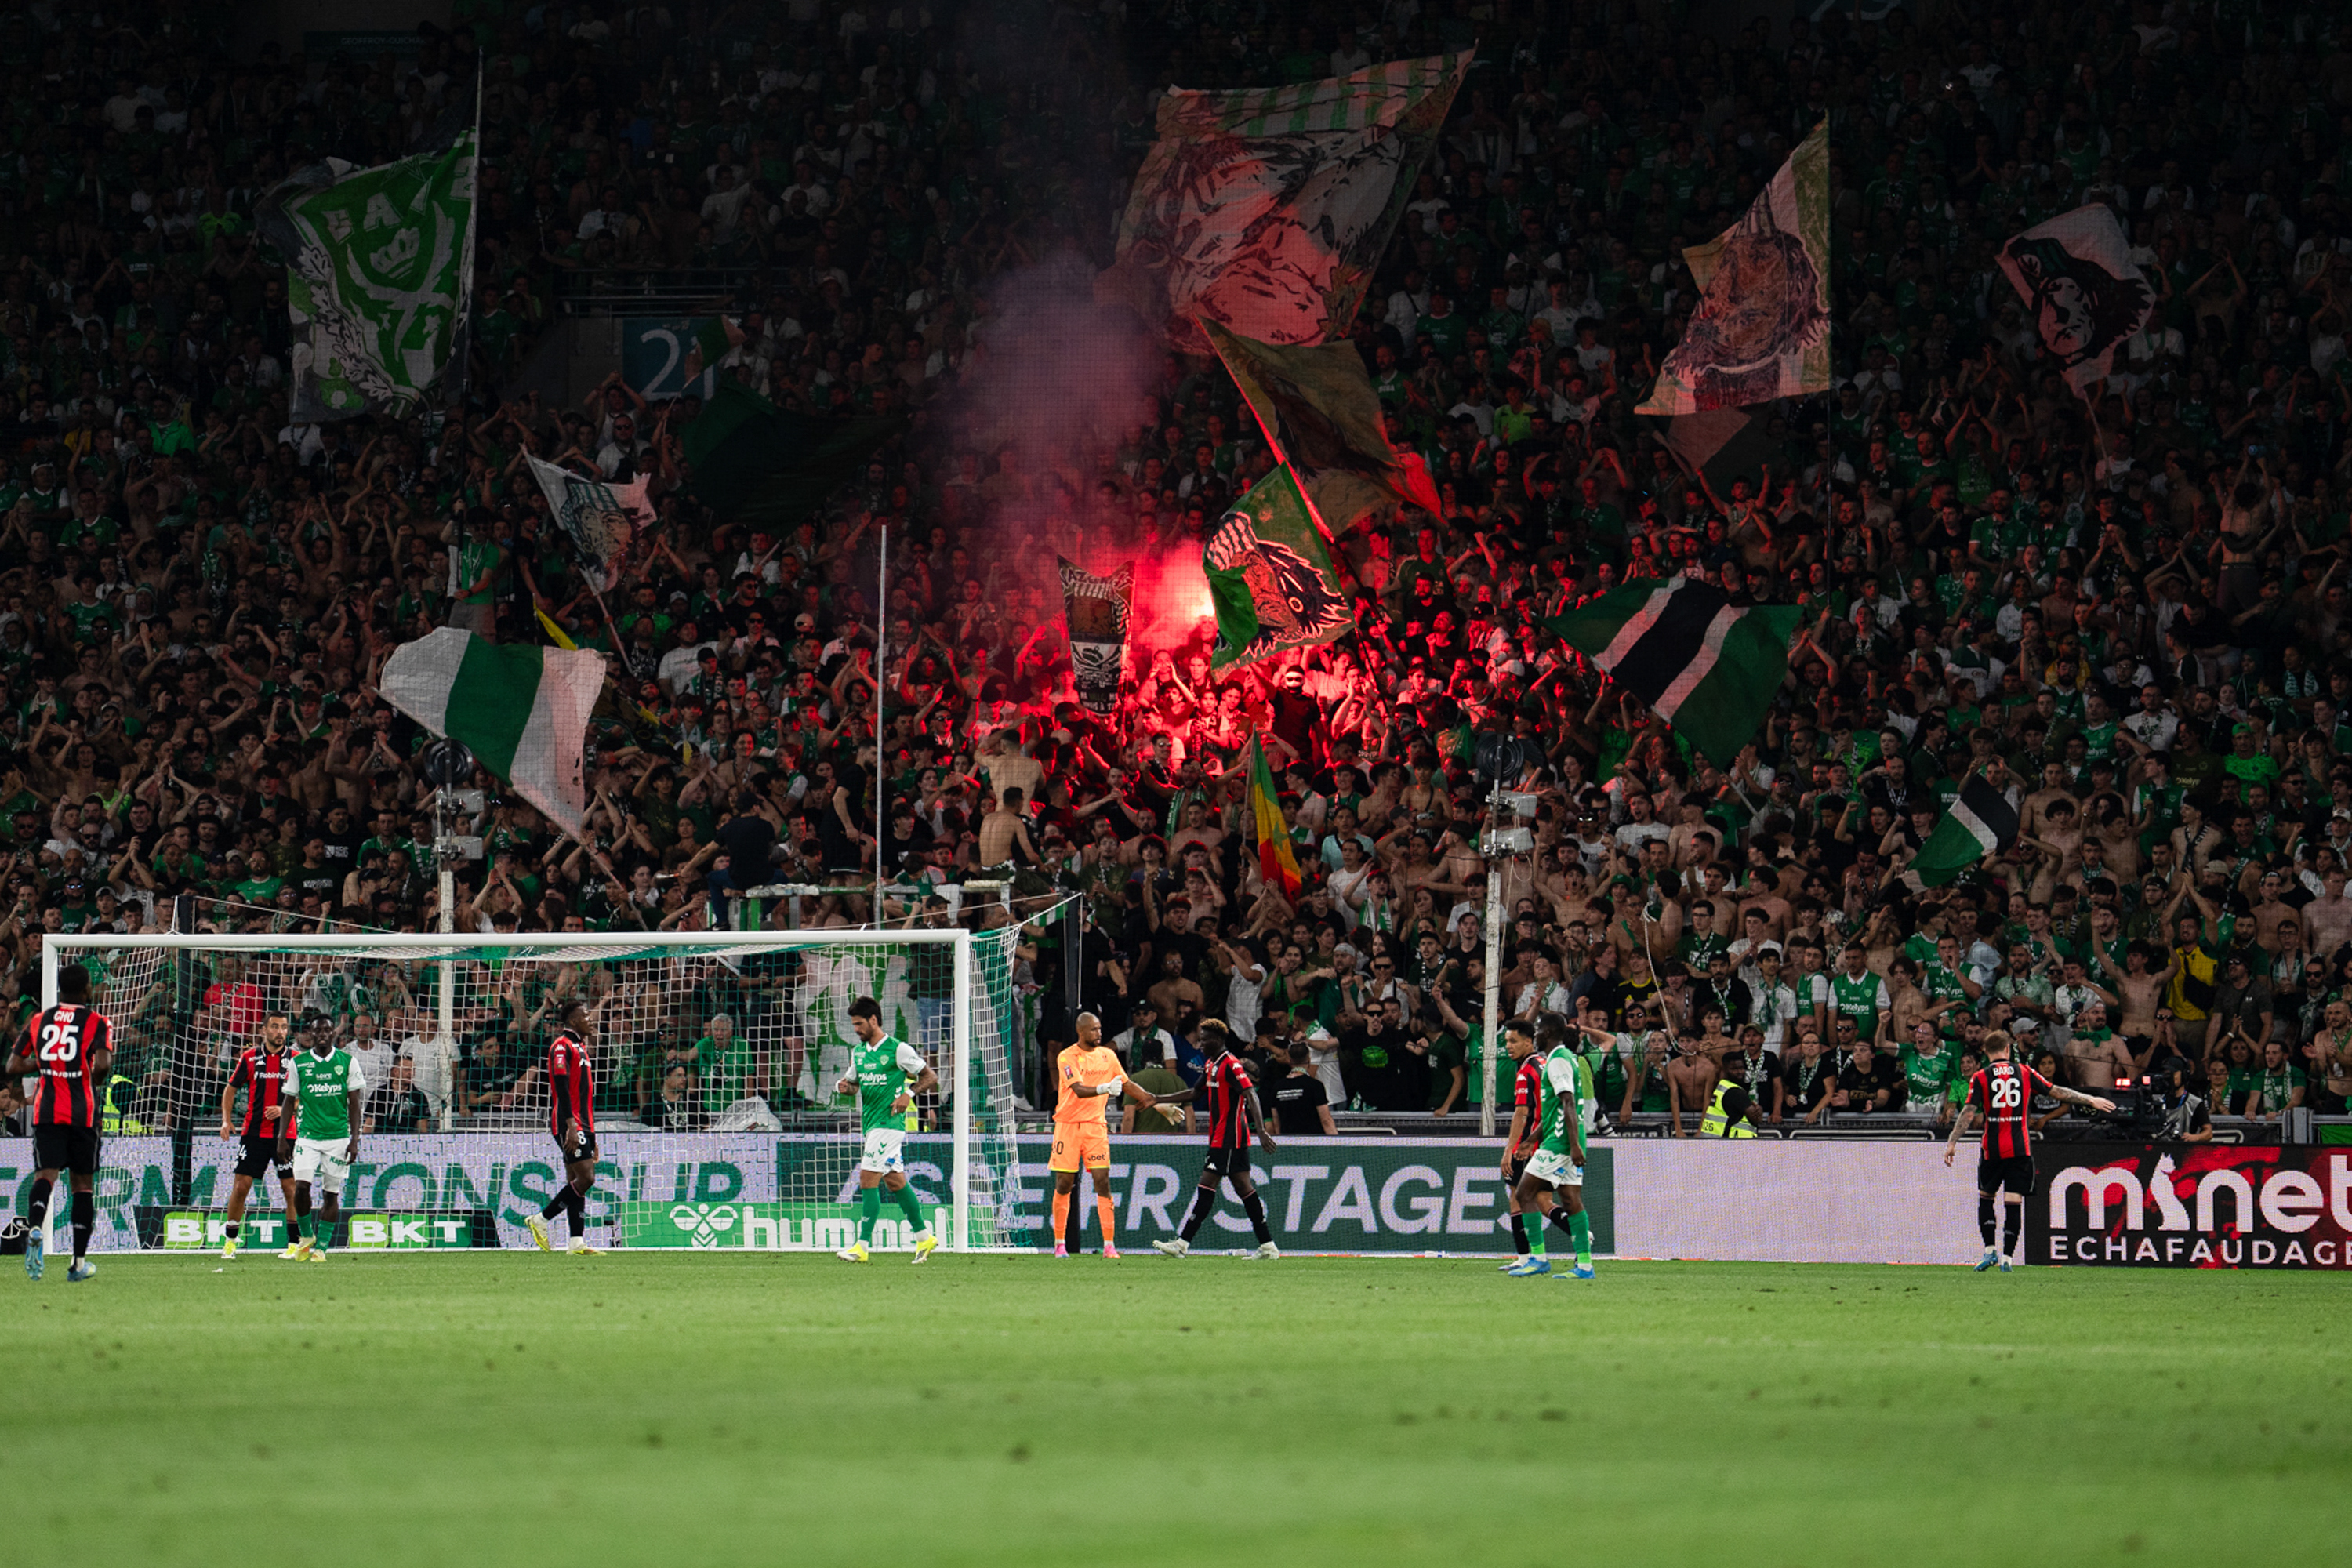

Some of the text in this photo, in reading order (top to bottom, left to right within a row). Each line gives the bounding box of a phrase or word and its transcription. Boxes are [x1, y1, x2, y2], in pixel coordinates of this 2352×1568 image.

[53, 1011, 75, 1022] CHO
[40, 1024, 79, 1062] 25
[1993, 1066, 2015, 1076] BARD
[314, 1083, 343, 1094] Kelyps
[1991, 1077, 2021, 1108] 26
[1087, 1152, 1107, 1162] vbet
[166, 1219, 283, 1243] BKT
[351, 1220, 466, 1243] BKT
[742, 1205, 947, 1248] hummel
[2050, 1235, 2352, 1265] ECHAFAUDAG
